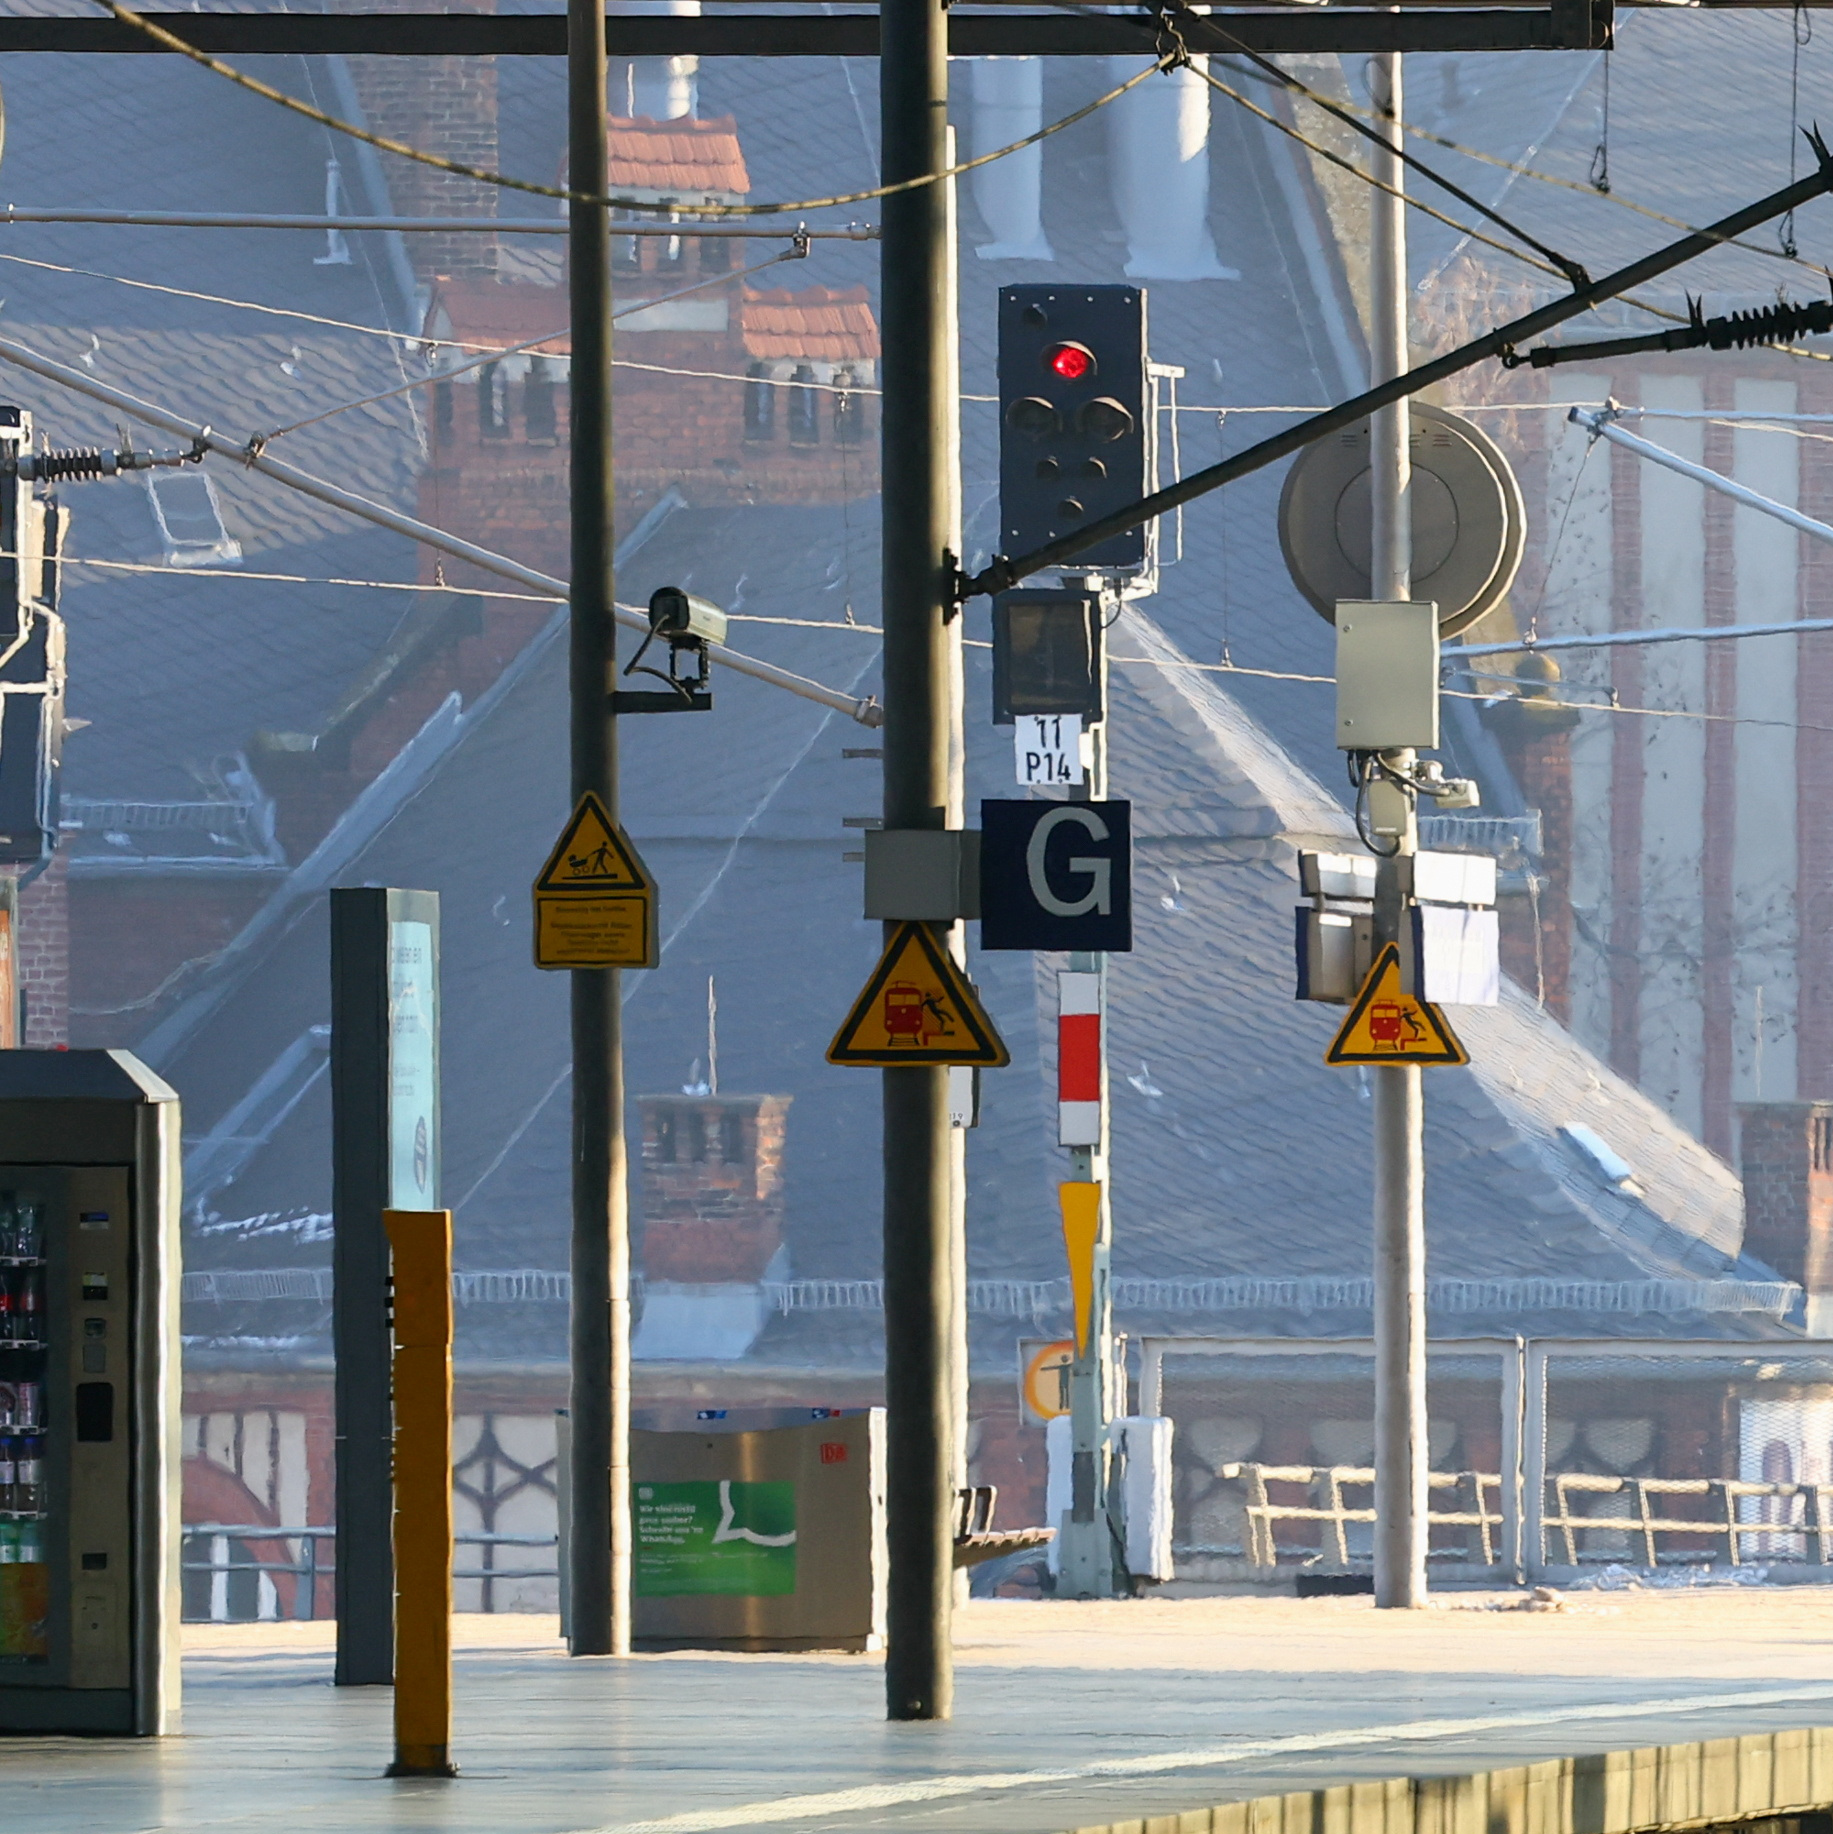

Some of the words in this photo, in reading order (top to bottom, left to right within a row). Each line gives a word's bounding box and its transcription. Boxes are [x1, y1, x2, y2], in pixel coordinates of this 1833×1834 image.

[1036, 718, 1060, 750] 11
[1026, 751, 1071, 781] P14
[1026, 806, 1111, 917] G
[949, 1112, 963, 1120] 19
